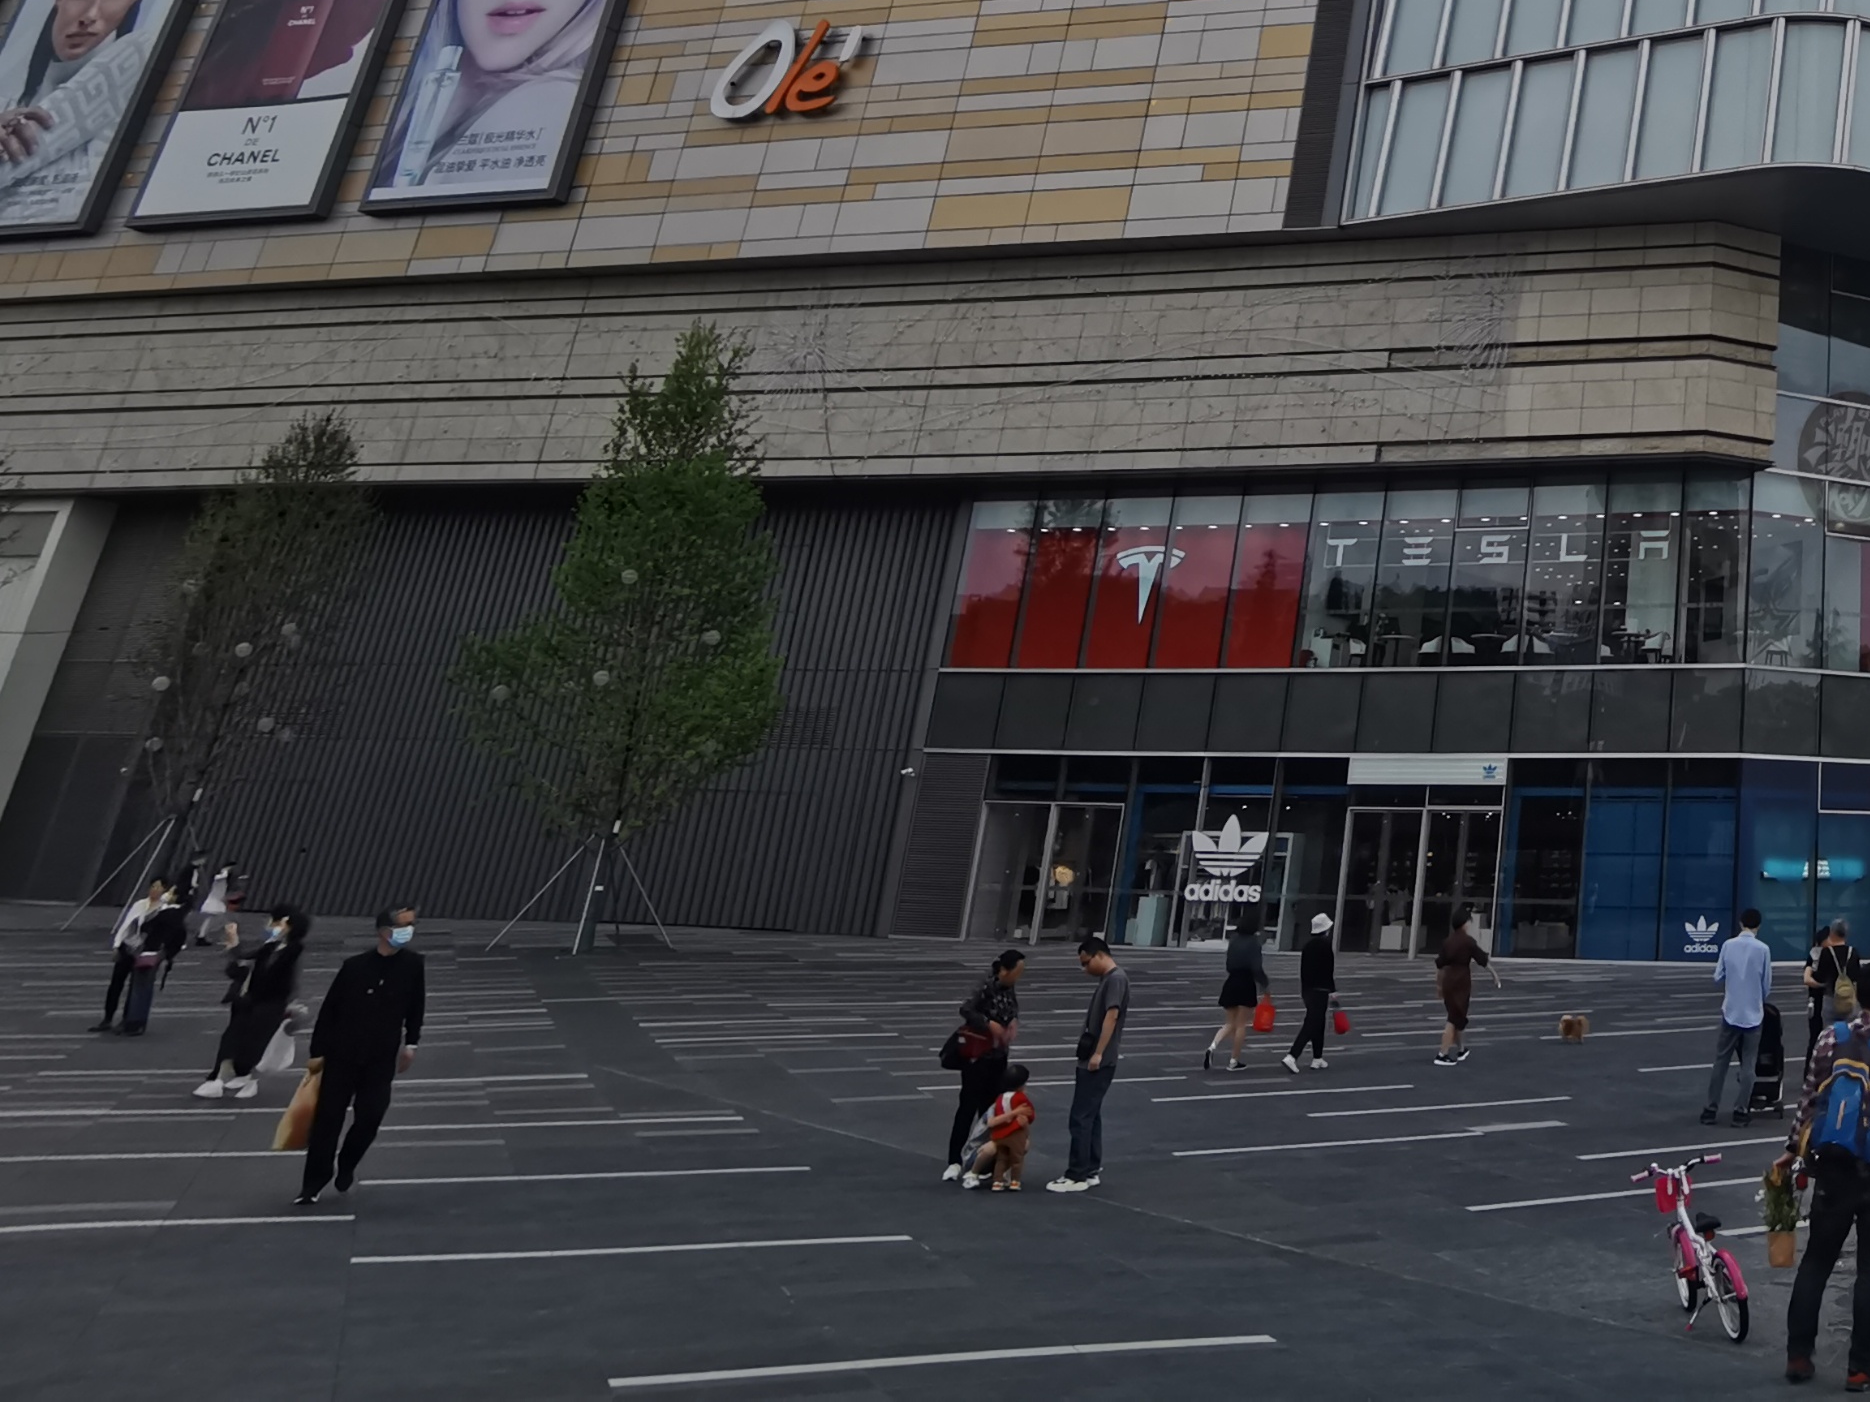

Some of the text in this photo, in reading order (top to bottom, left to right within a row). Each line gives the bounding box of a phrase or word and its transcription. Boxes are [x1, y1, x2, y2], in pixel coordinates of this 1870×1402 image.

[206, 148, 280, 167] CHANEL
[1326, 529, 1670, 567] TESLA
[1184, 879, 1262, 902] adidas
[1683, 943, 1719, 953] adidas
